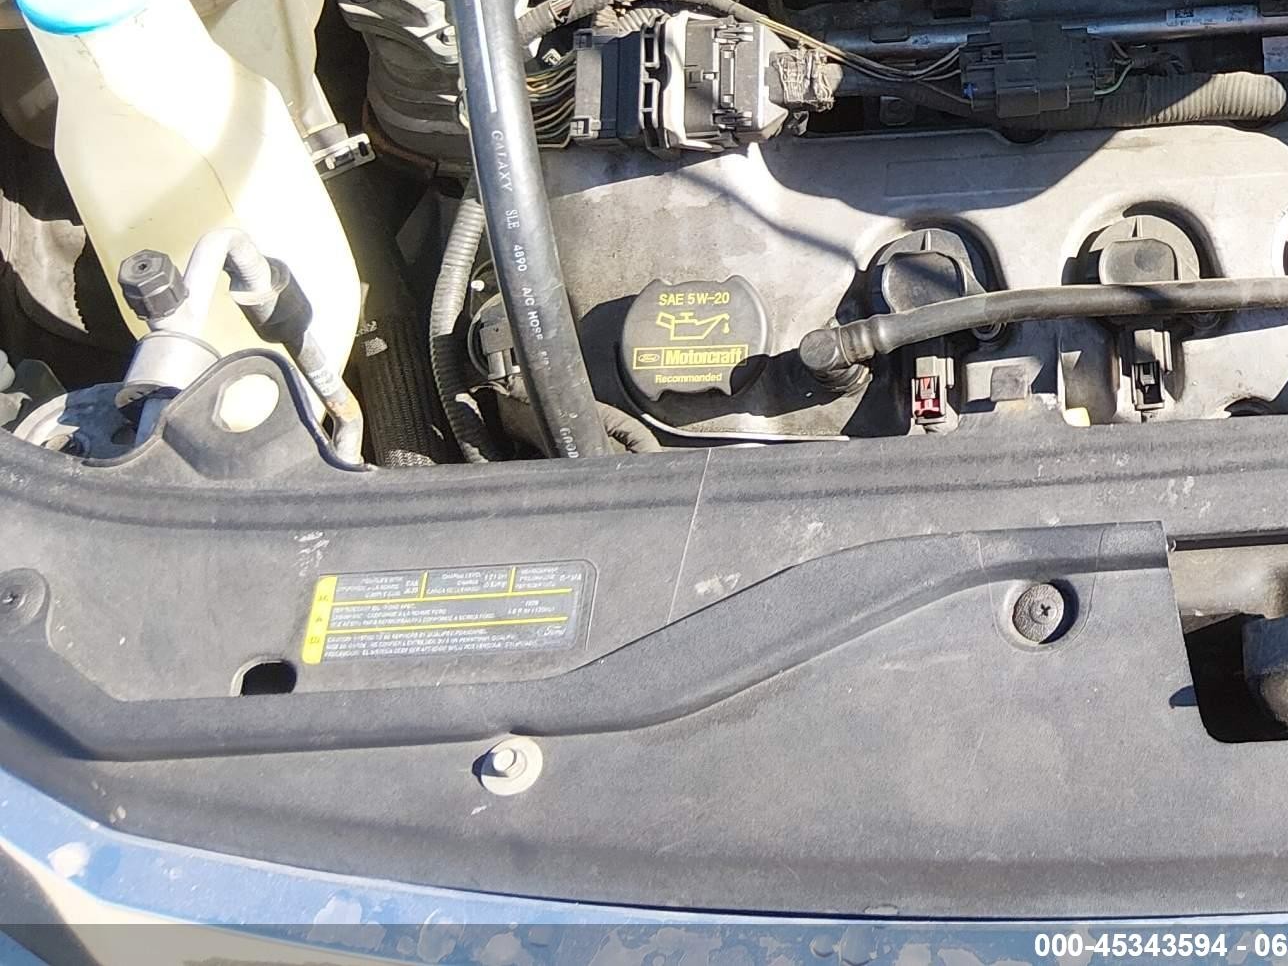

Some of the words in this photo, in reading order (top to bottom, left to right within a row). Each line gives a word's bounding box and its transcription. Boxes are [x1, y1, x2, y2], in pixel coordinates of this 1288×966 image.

[491, 130, 513, 192] GALAXY
[505, 209, 520, 230] SLE
[513, 243, 528, 272] 4890
[521, 287, 535, 307] A/C
[658, 293, 684, 306] SAE
[687, 291, 730, 305] 5W-20
[665, 347, 742, 365] Motorcraft
[655, 373, 722, 383] Recommended
